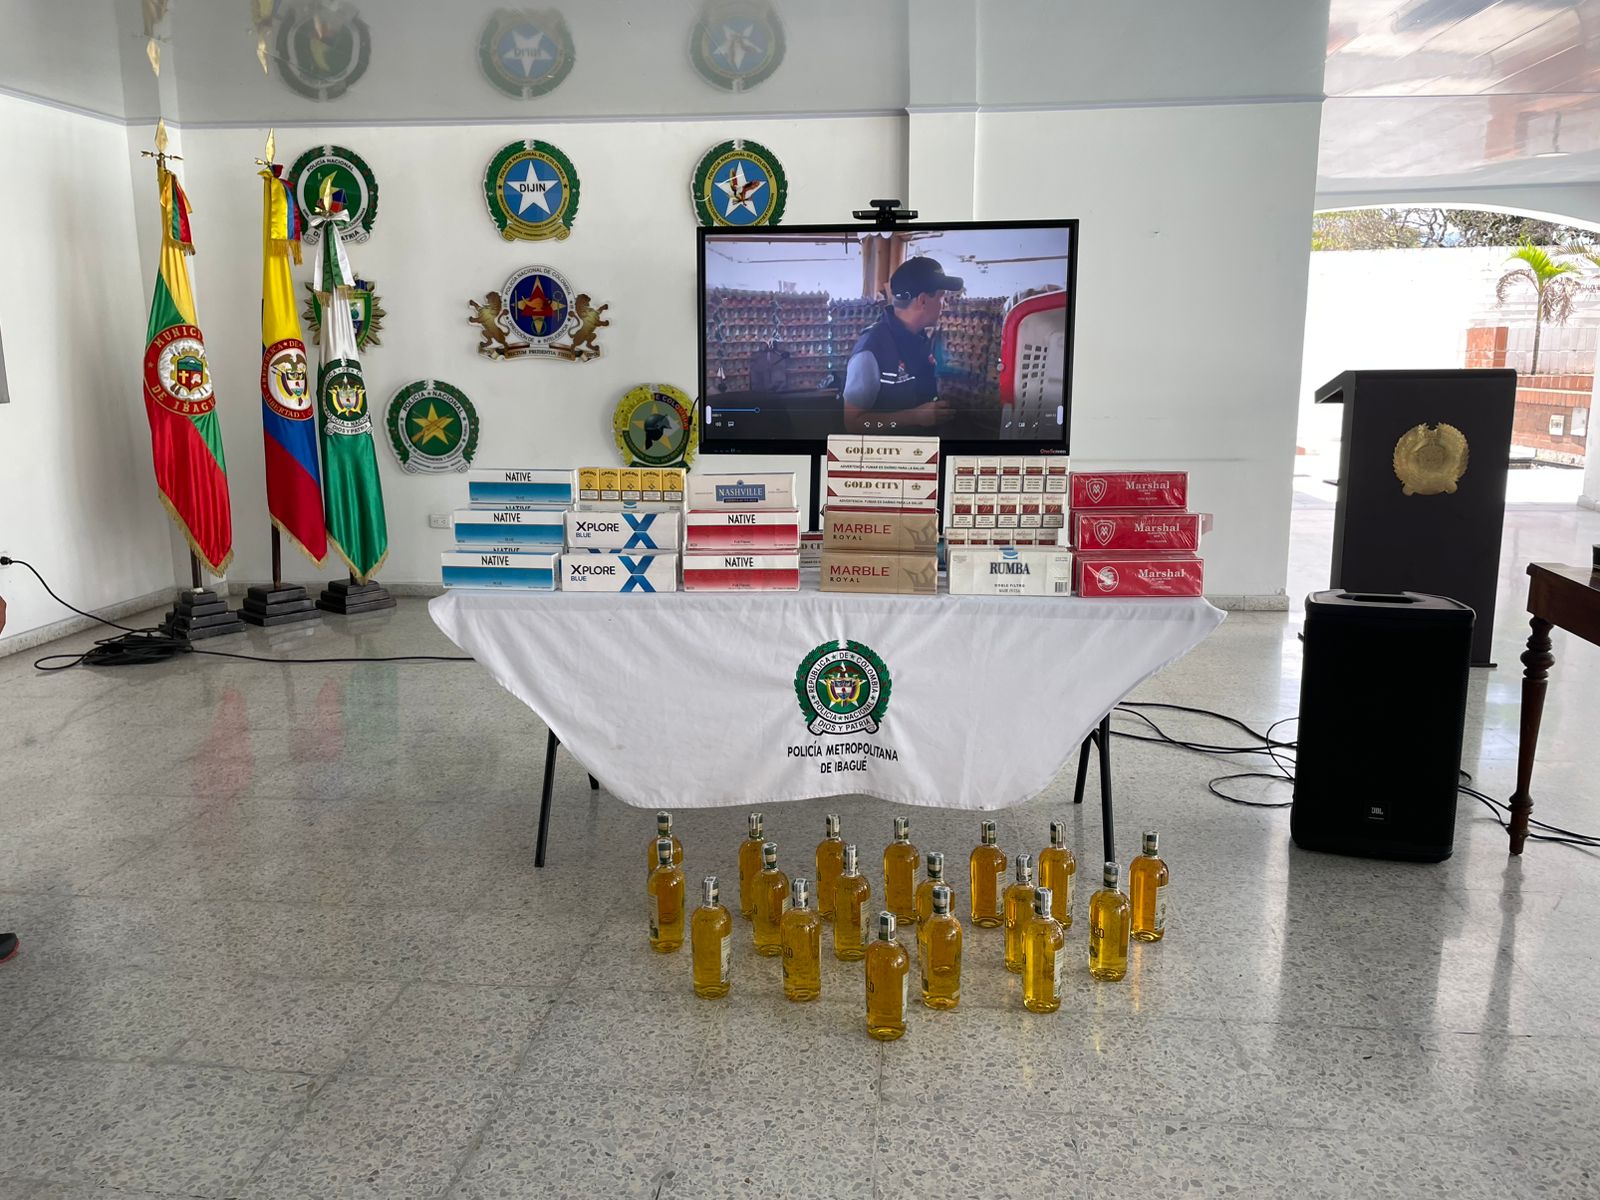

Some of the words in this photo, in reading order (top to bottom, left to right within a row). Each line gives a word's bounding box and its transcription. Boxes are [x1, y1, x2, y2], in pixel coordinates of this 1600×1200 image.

[512, 152, 538, 162] NACIONAL
[720, 152, 745, 162] NACIONAL
[326, 158, 354, 172] NACIONAL
[520, 184, 546, 192] DIJIN
[340, 230, 360, 240] ATRIA
[518, 267, 542, 278] NACIONAL
[552, 270, 572, 296] COLOMBIA
[152, 384, 168, 400] DE
[265, 394, 300, 418] LIBERTAD
[432, 391, 464, 415] NACIONAL
[845, 447, 875, 456] GOLD
[876, 447, 902, 456] CITY
[506, 472, 532, 482] NATIVE
[844, 481, 873, 489] GOLD
[875, 481, 900, 490] CITY
[1125, 480, 1170, 490] Marshal
[718, 488, 762, 496] NASHVILLE
[494, 512, 521, 522] NATIVE
[728, 514, 756, 524] NATIVE
[576, 521, 620, 532] XPLORE
[833, 523, 892, 534] MARBLE
[1134, 522, 1180, 532] Marshal
[481, 556, 510, 566] NATIVE
[724, 557, 754, 567] NATIVE
[570, 564, 616, 575] XPLORE
[830, 566, 890, 577] MARBLE
[990, 562, 1030, 575] RUMBA
[1138, 568, 1185, 578] Marshal
[856, 657, 878, 694] COLOMBIA
[844, 702, 874, 720] NACIONAL
[818, 720, 836, 732] DIOS
[846, 718, 871, 731] PATRIA
[788, 740, 822, 758] POLICÍA
[826, 742, 898, 761] METROPOLITANA
[820, 762, 832, 773] DE
[834, 756, 867, 772] IBAGUÉ
